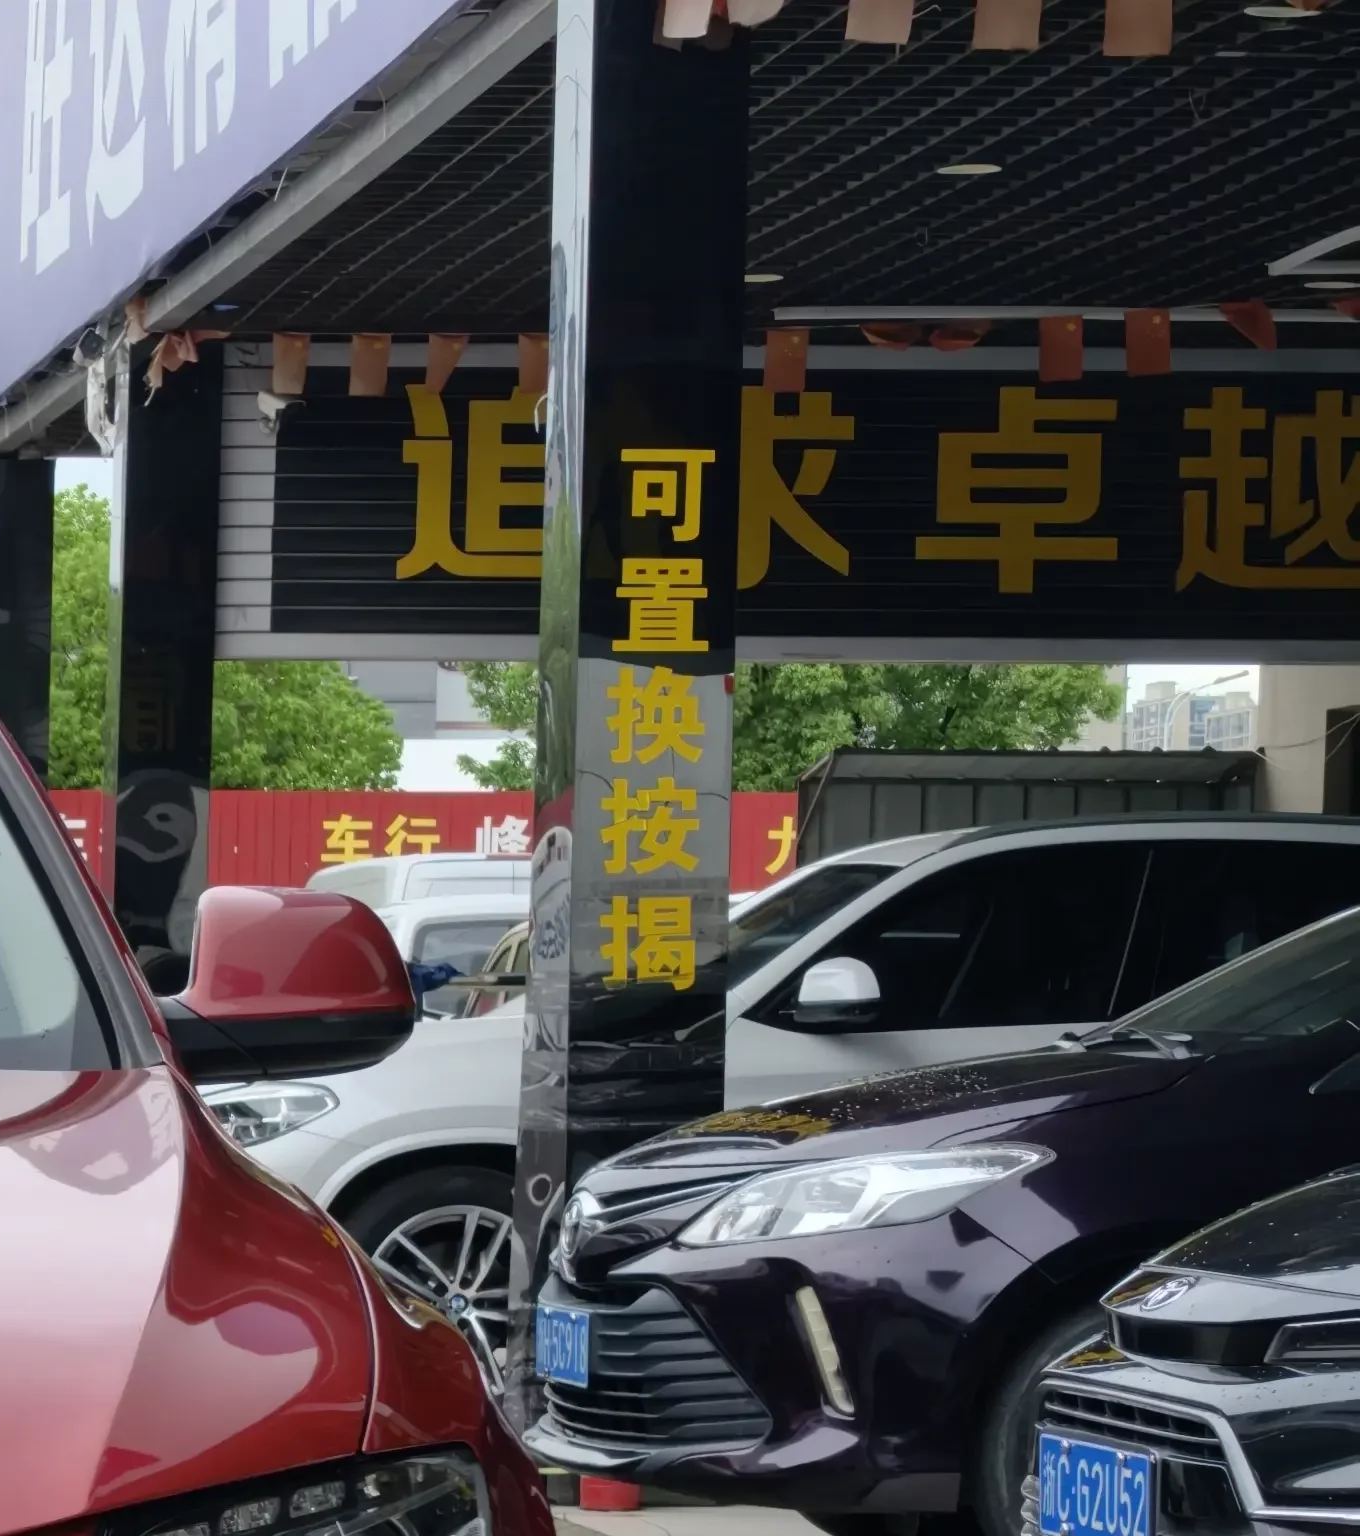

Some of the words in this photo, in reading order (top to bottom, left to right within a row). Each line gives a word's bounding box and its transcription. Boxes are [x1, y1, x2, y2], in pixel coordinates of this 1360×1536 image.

[320, 814, 440, 864] 车行
[599, 448, 716, 991] 可置换按揭
